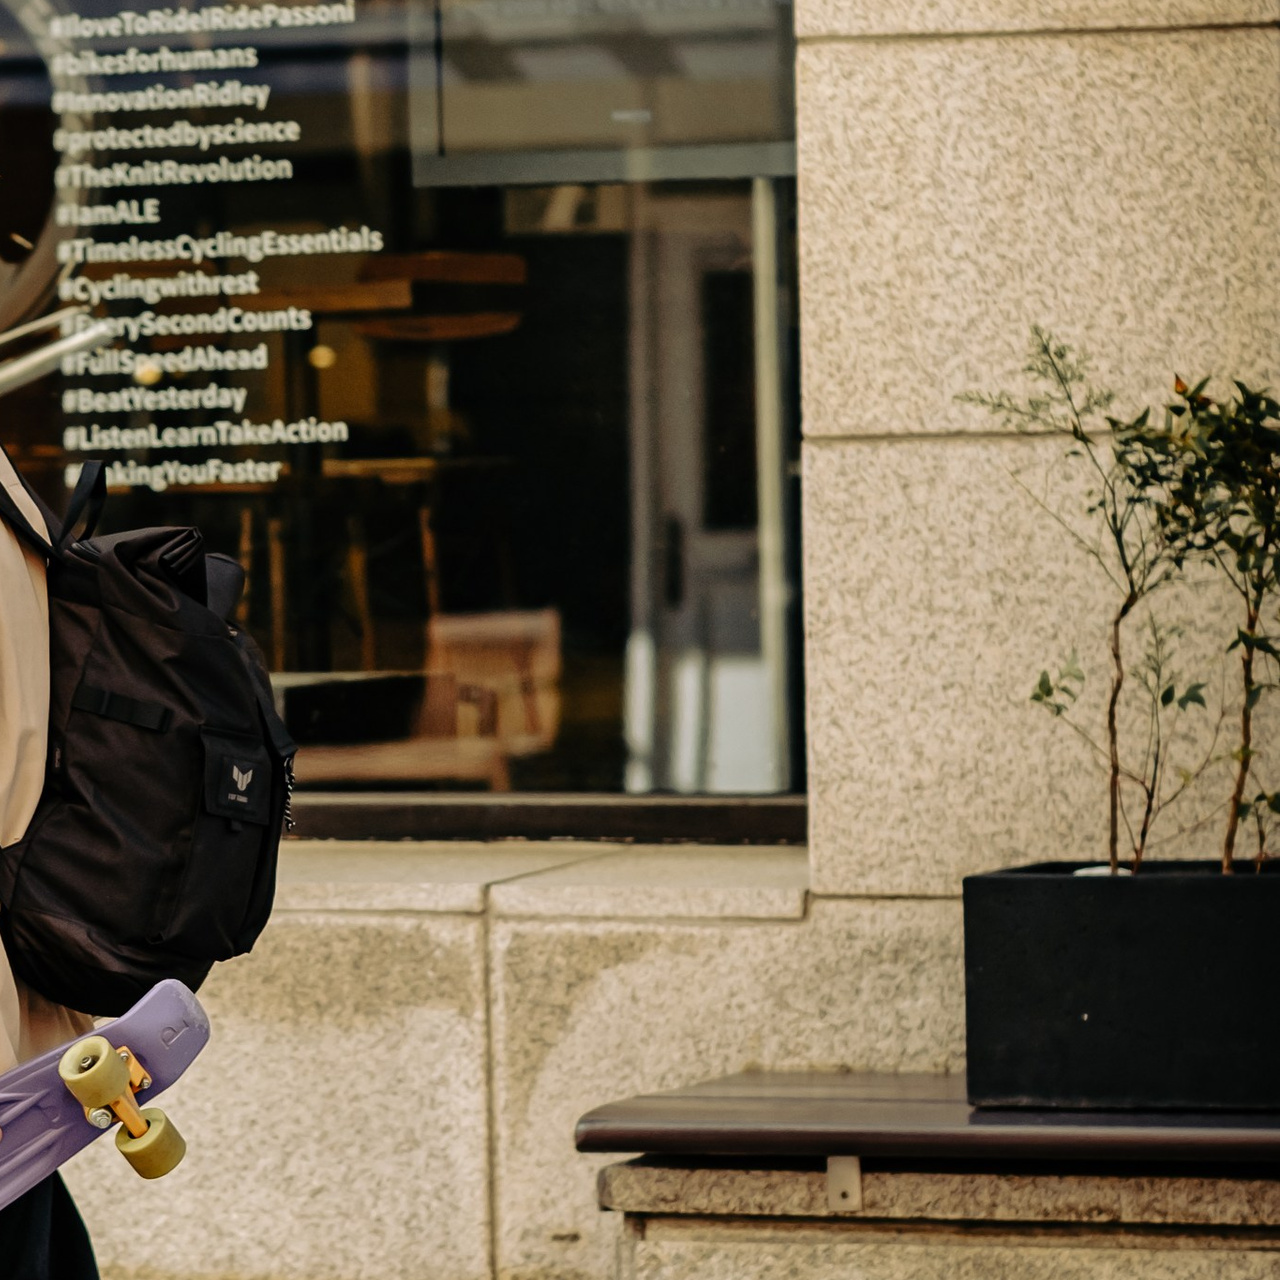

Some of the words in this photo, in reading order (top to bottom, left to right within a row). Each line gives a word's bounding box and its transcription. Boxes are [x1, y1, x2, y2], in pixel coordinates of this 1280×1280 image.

[52, 46, 258, 77] #bikesforhumans
[53, 117, 301, 153] #protectedbyscience
[55, 154, 293, 190] #TheKnitRevolution
[56, 225, 384, 264] #TimelessCyclingEssentials
[60, 343, 269, 376] #FullSpeedAhead
[62, 382, 248, 413] #BeatYesterday
[63, 416, 349, 451] #ListenLearnTakeAction
[64, 458, 282, 492] #akingYouFaster
